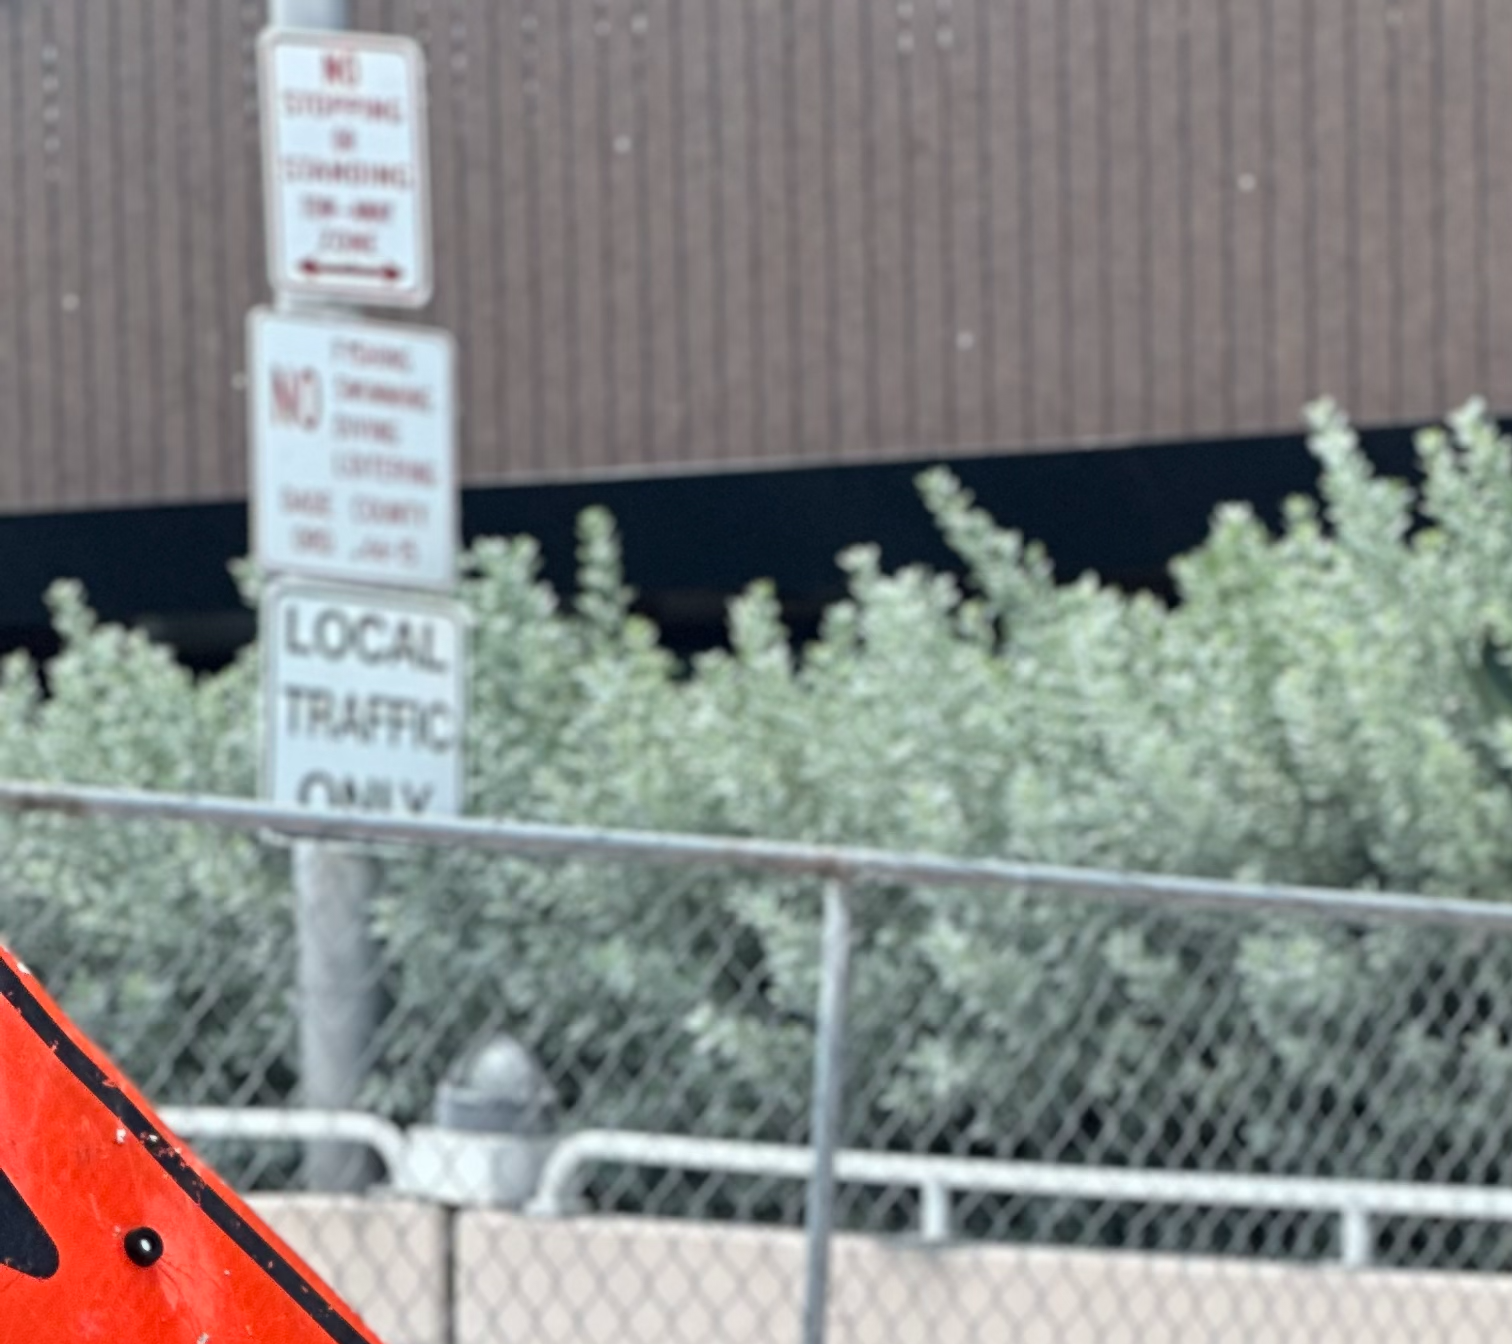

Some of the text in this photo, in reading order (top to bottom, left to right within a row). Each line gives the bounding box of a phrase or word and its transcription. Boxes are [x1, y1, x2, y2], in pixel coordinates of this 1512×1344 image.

[321, 52, 361, 86] NO
[283, 89, 402, 124] STOPPING
[269, 363, 324, 432] NO
[285, 604, 448, 675] LOCAL
[285, 684, 456, 754] TRAFFIC
